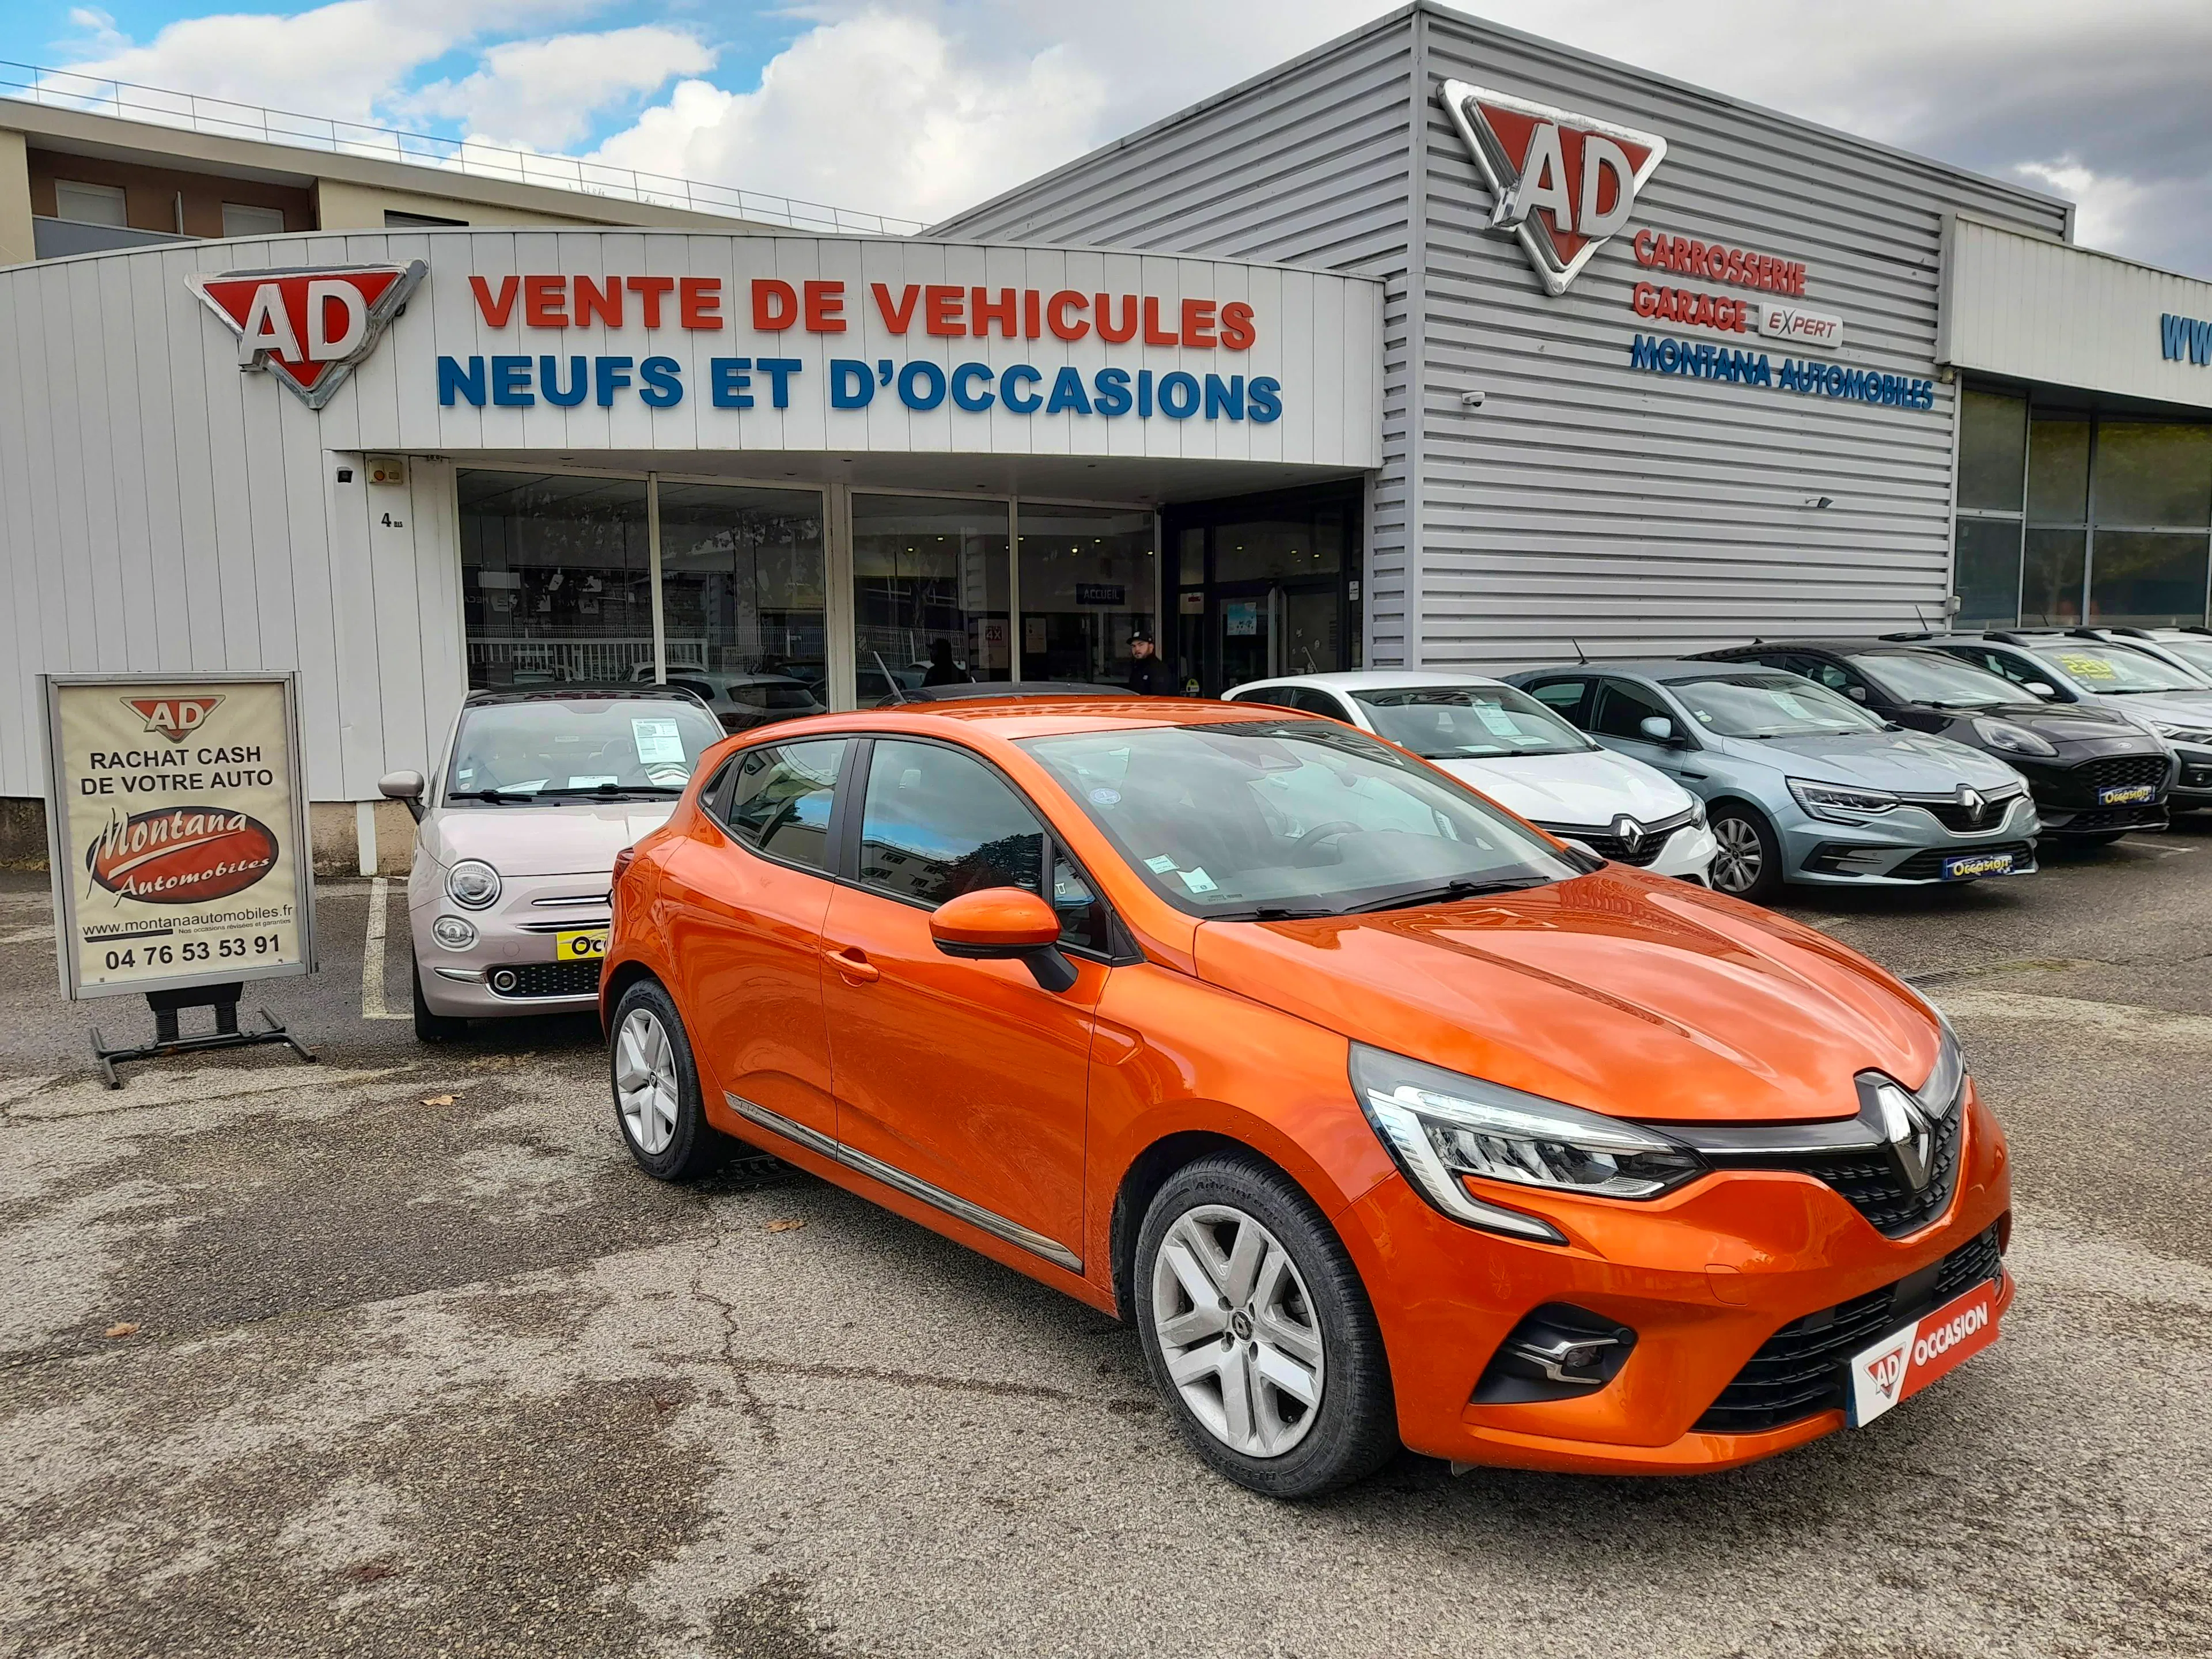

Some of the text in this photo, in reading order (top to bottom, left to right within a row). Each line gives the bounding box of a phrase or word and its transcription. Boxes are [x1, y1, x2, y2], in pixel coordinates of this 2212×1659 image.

[1505, 122, 1635, 237] AD
[1634, 229, 1806, 297] CARROSSERIE
[238, 279, 369, 369] AD
[468, 274, 1256, 351] VENTE DE VEHICULES
[1634, 281, 1748, 334] GARAGE
[437, 354, 1283, 423] NEUFS ET D'OCCASIONS
[1631, 334, 1934, 410] MONTANA AUTOMOBILES
[381, 513, 392, 527] 4
[1084, 589, 1119, 599] ACCUEIL
[143, 701, 205, 732] AD
[81, 769, 273, 796] DE VOTRE AUTO
[90, 746, 261, 770] RACHAT CASH
[86, 808, 247, 899] Montana
[1953, 858, 2009, 876] Occasion
[113, 857, 270, 908] Automobiles
[82, 904, 293, 935] www.montanaautomobiles.fr
[263, 919, 291, 927] garanties
[105, 934, 279, 970] 04 76 53 53 91
[1876, 1301, 1988, 1391] AD OCCASION
